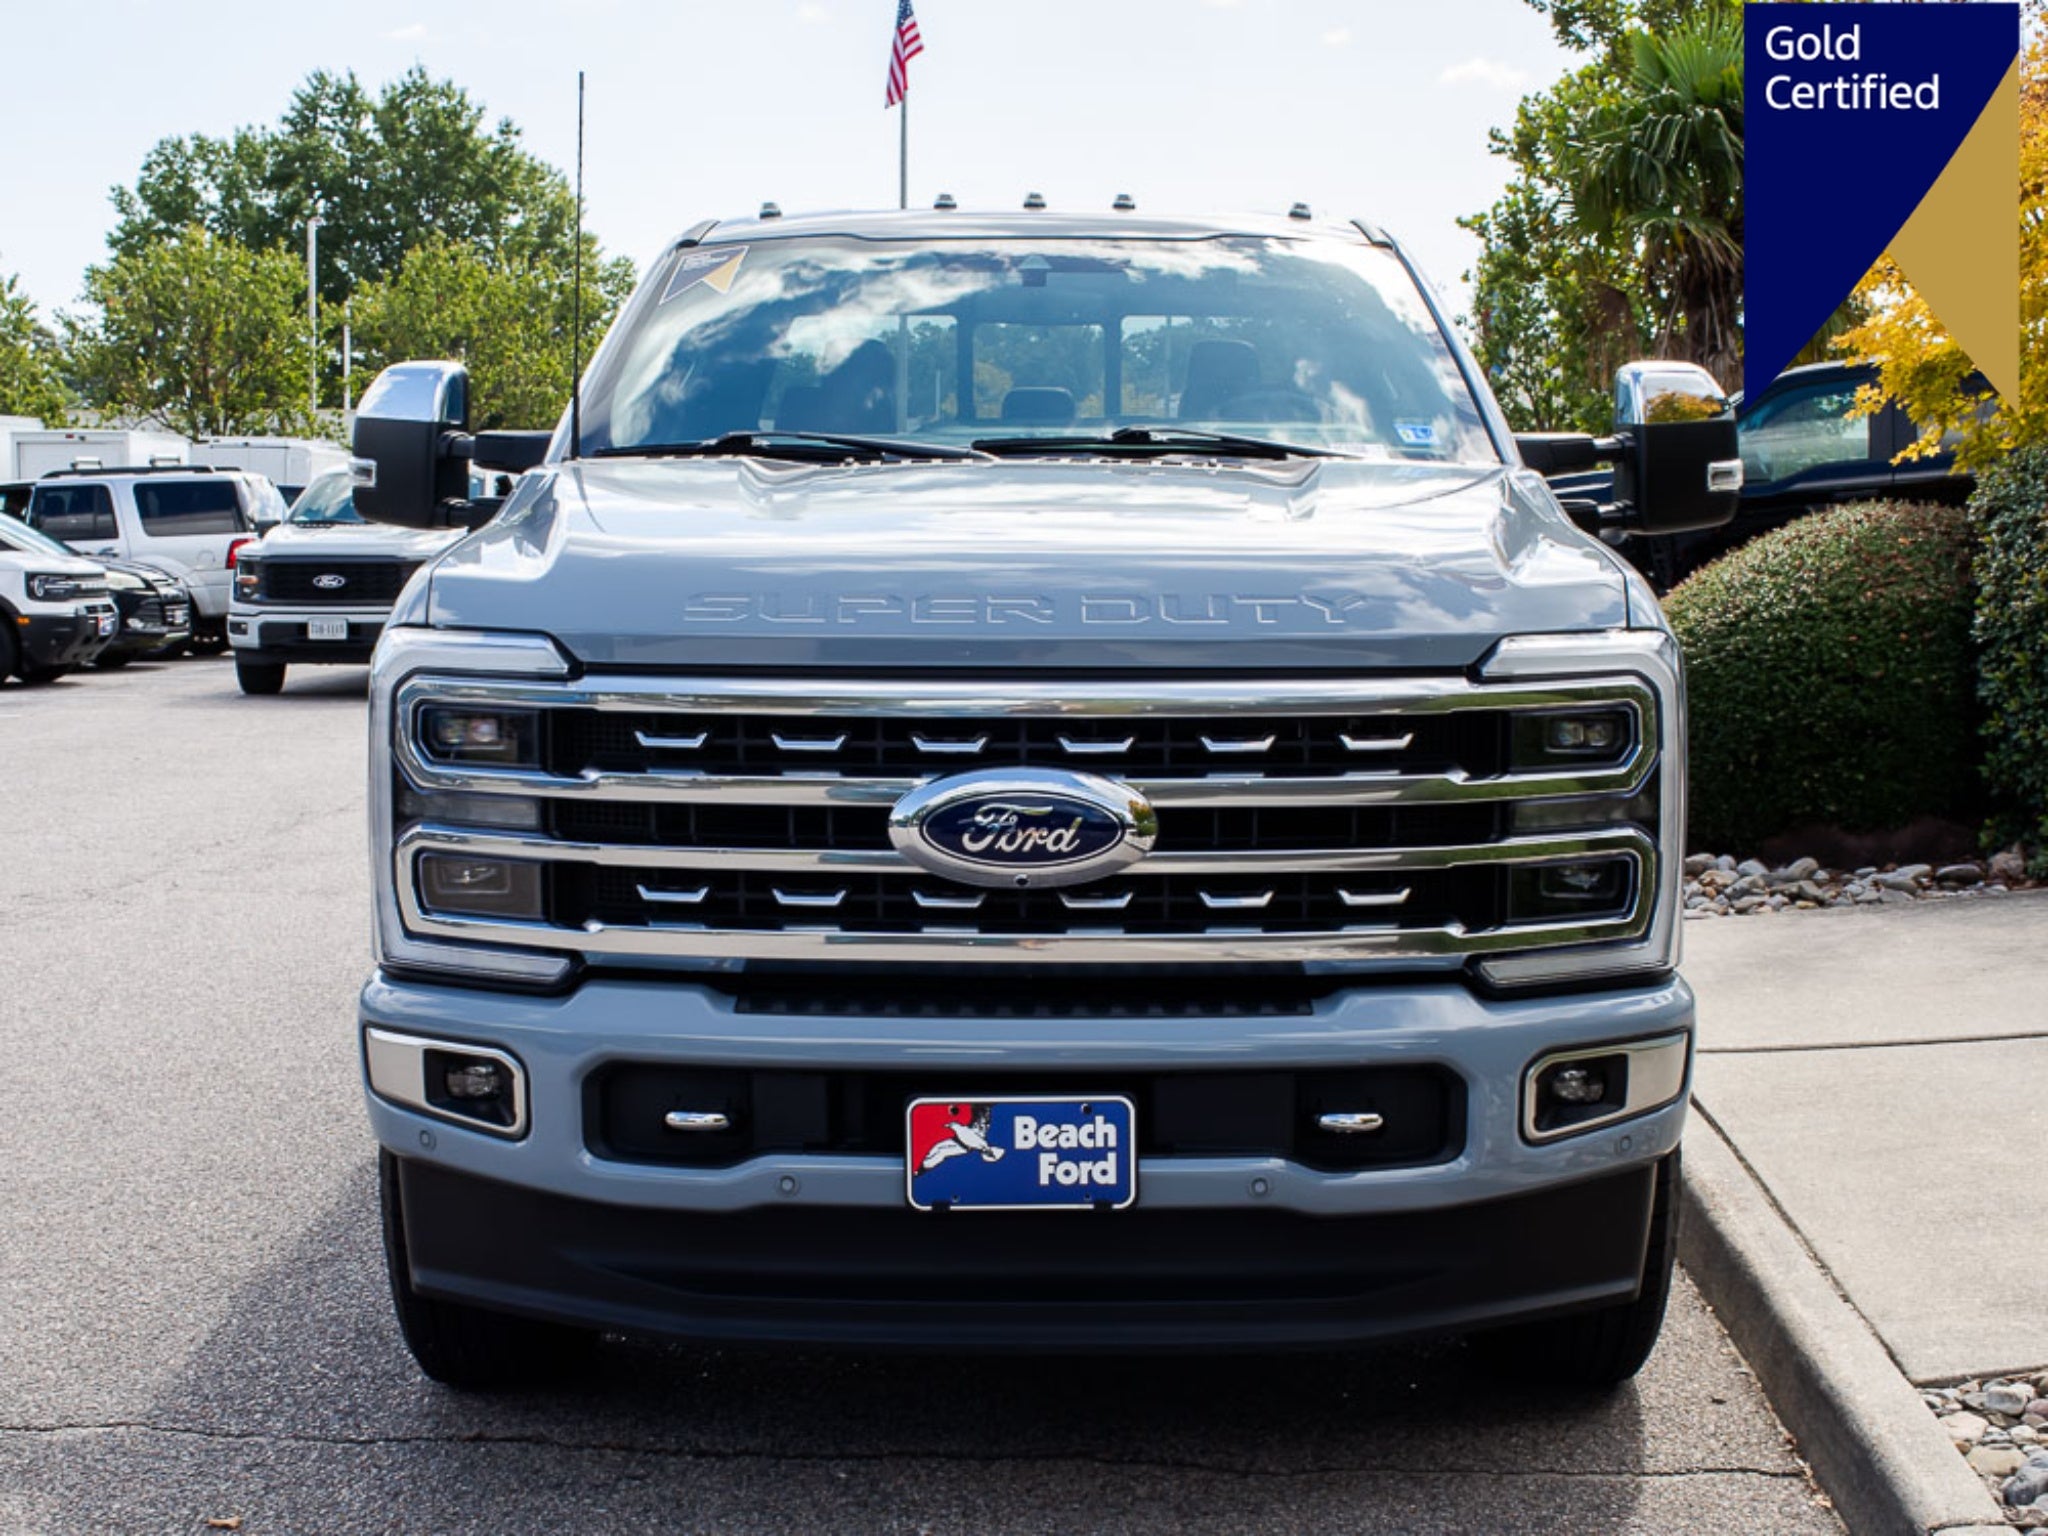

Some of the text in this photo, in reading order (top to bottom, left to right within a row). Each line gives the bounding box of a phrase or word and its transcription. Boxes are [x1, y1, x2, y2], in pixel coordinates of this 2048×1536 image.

[683, 592, 1369, 624] SUPER DUTY
[961, 803, 1084, 853] Ford
[1014, 1115, 1117, 1149] Beach
[1039, 1152, 1117, 1185] Ford
